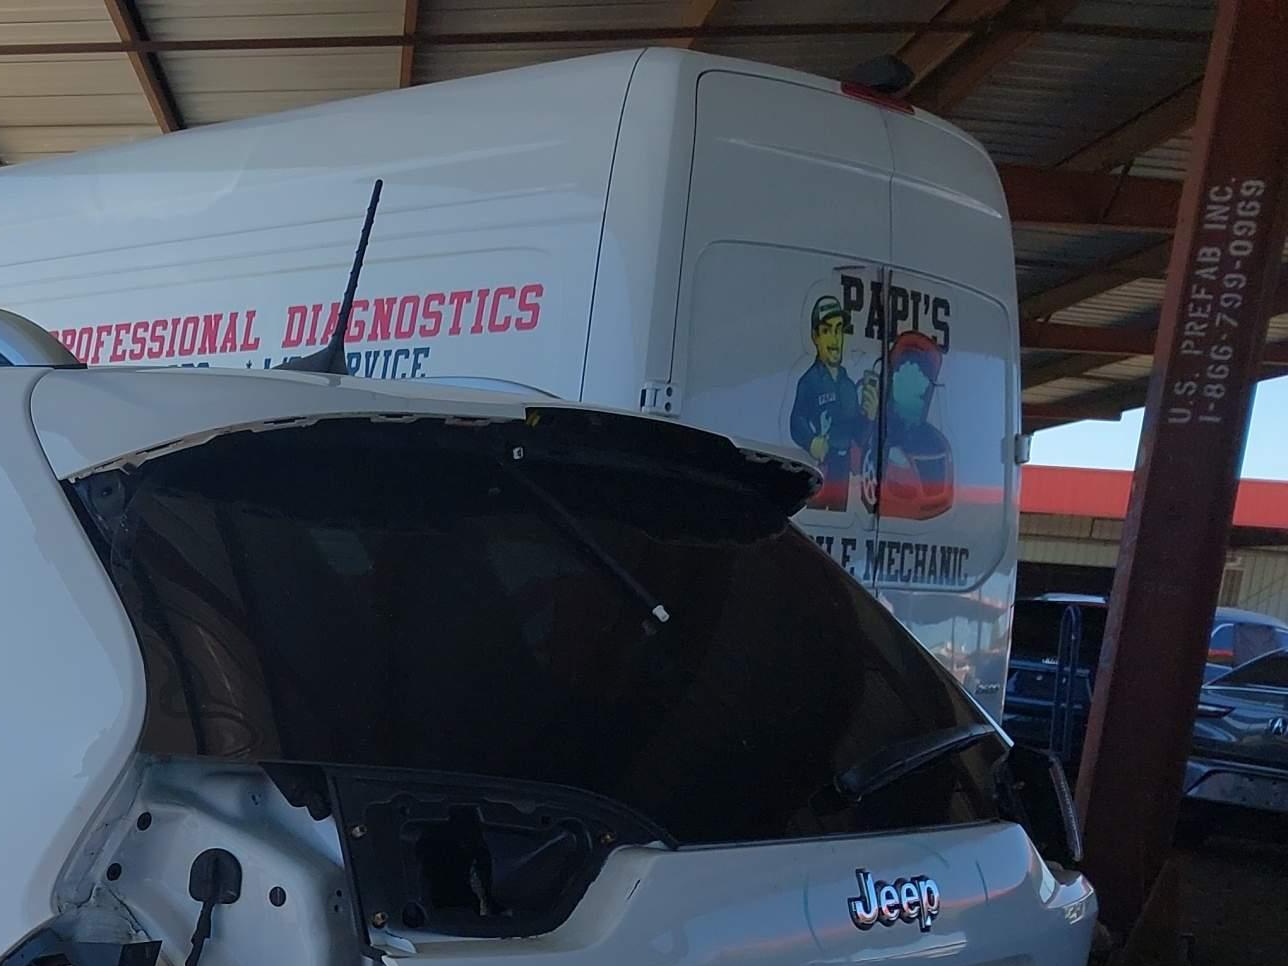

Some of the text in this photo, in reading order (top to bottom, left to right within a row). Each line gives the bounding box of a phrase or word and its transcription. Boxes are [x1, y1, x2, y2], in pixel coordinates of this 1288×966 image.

[281, 283, 544, 349] DIAGNOSTICS
[840, 273, 951, 355] PAPI'S
[1168, 178, 1236, 424] U.S. PREFAB INC.
[1199, 179, 1266, 424] 1-866-799-0969
[863, 538, 970, 587] MECHANIC
[847, 867, 941, 933] Jeep
